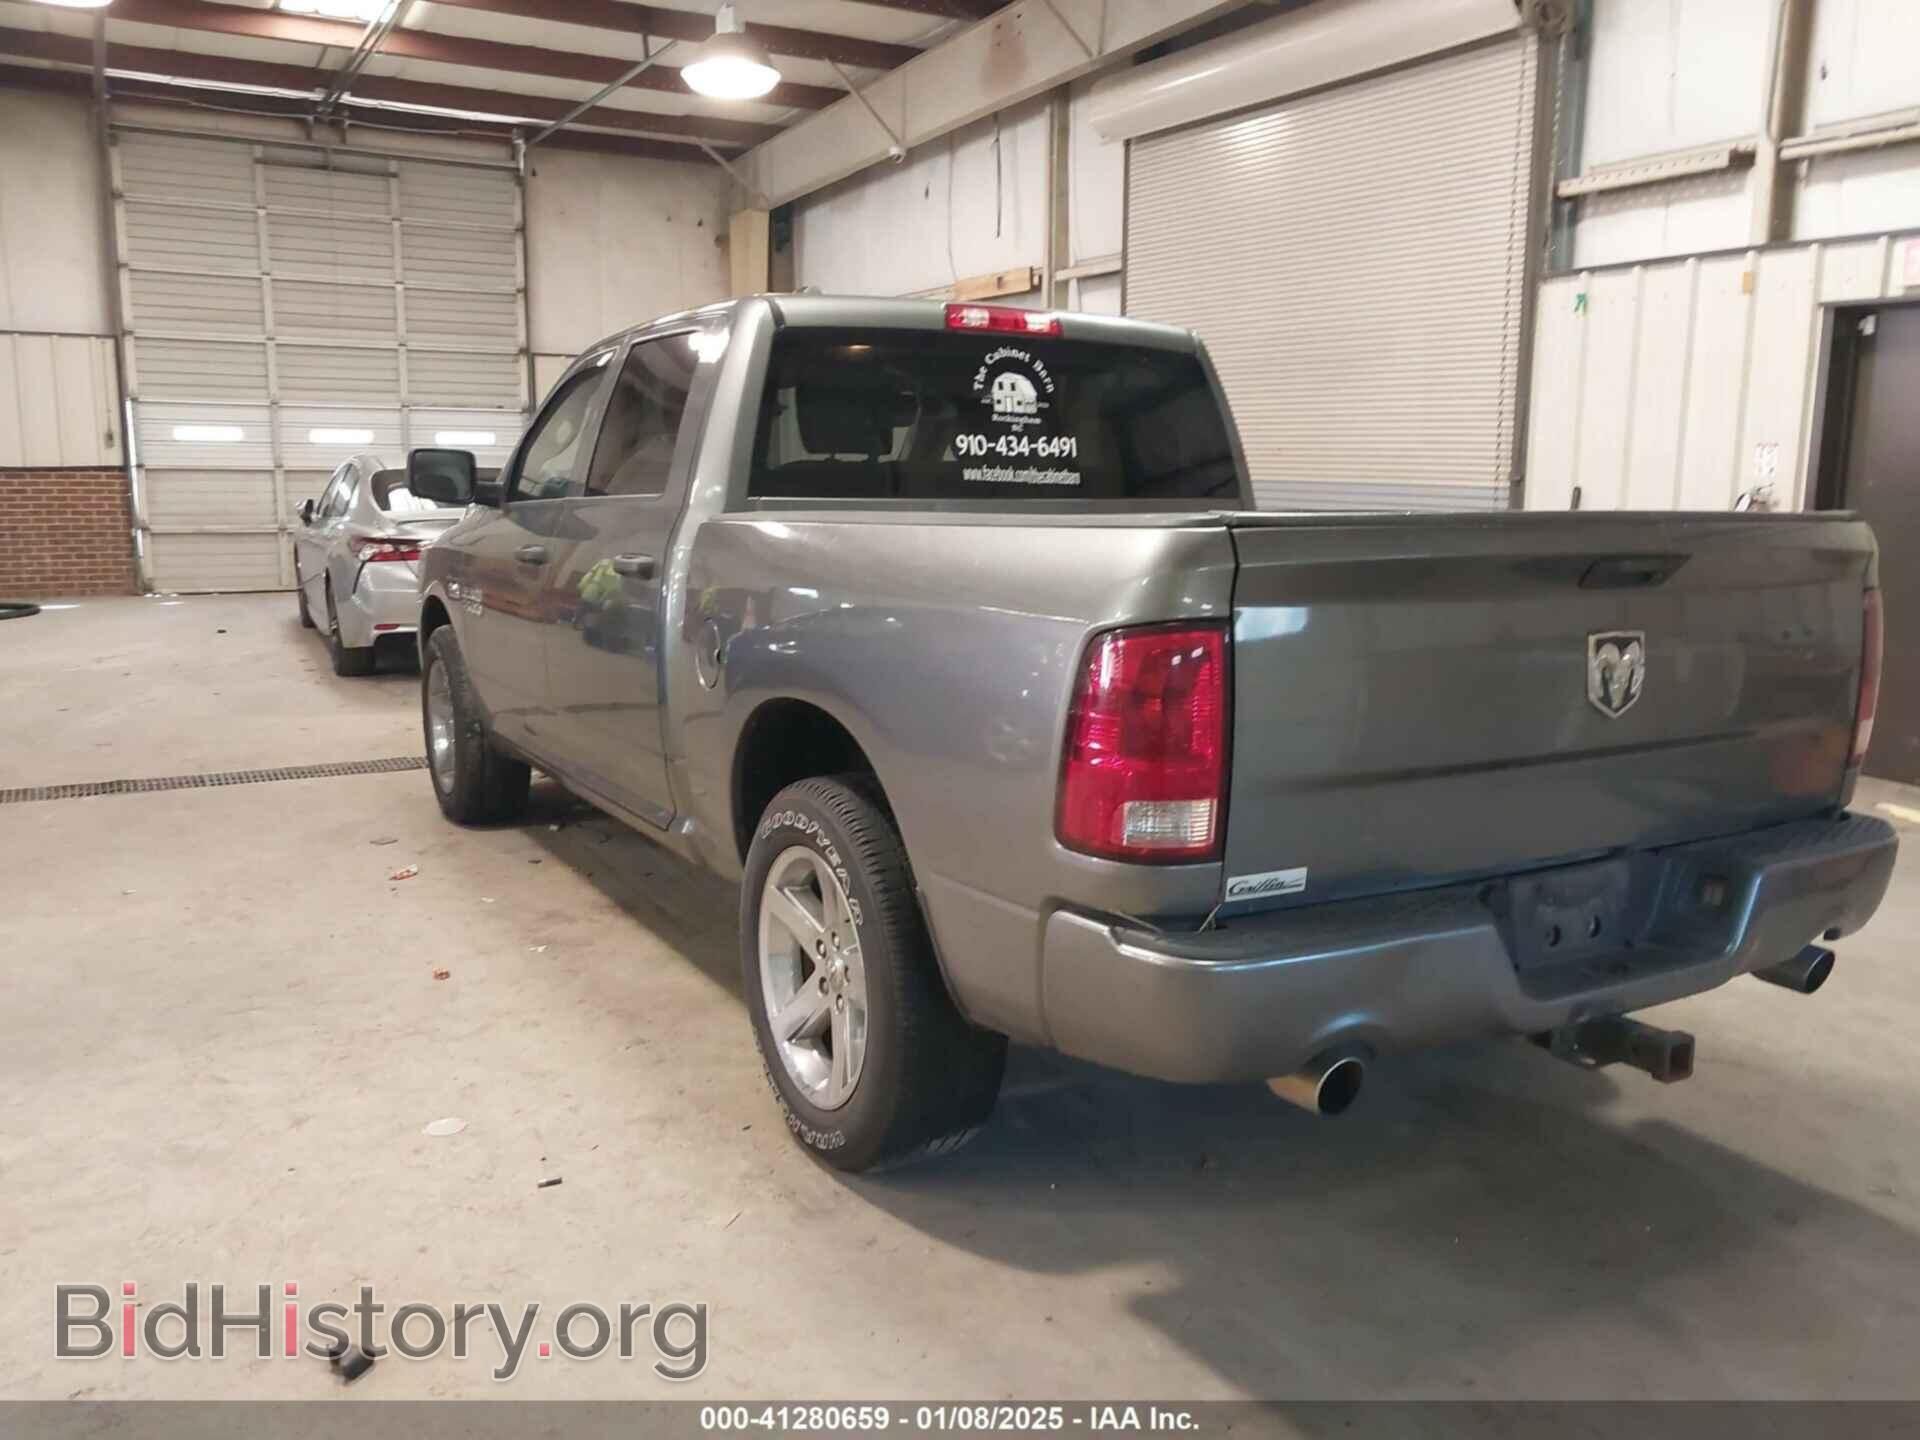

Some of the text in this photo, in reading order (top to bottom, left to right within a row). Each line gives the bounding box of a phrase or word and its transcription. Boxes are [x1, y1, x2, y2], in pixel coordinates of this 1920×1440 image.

[973, 346, 1055, 393] The Cabinet Barn
[955, 434, 1078, 458] 910-434-6491
